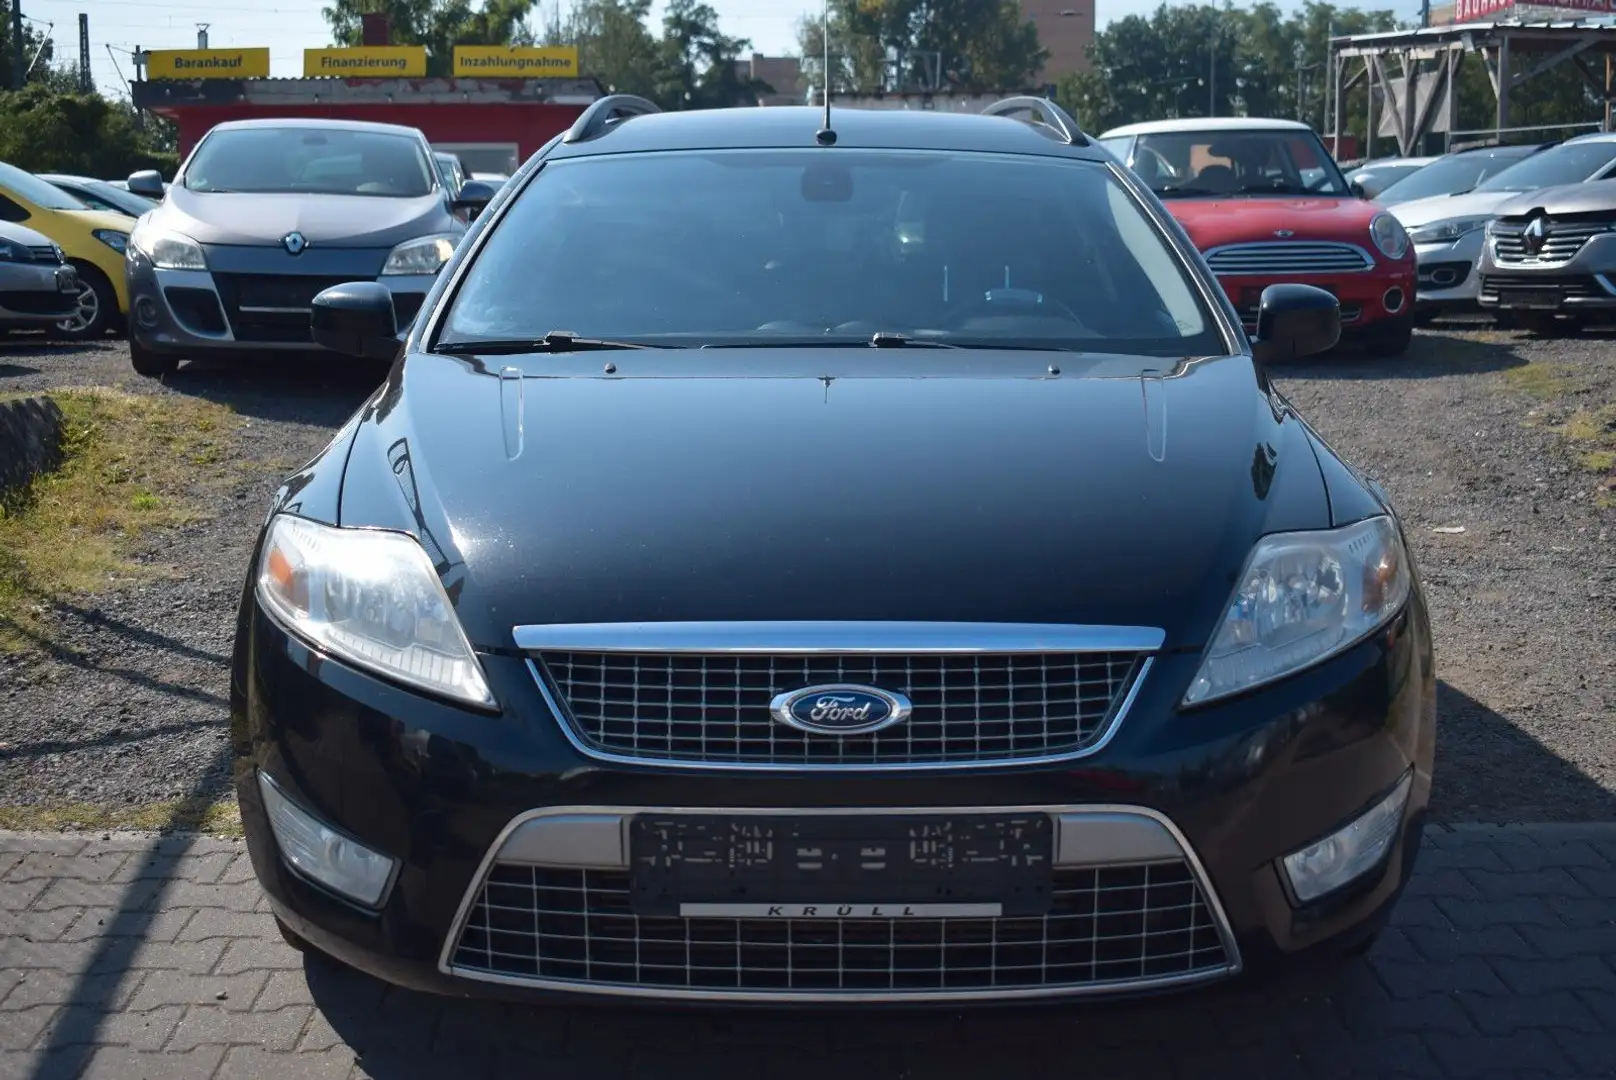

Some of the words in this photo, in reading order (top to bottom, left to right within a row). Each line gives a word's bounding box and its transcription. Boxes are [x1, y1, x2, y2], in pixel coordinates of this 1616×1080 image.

[174, 55, 242, 69] Barankauf
[320, 56, 407, 69] Finanzierung
[460, 56, 572, 69] Inzahlungnahme
[811, 696, 871, 721] Ford
[768, 903, 915, 916] KRÜLL
